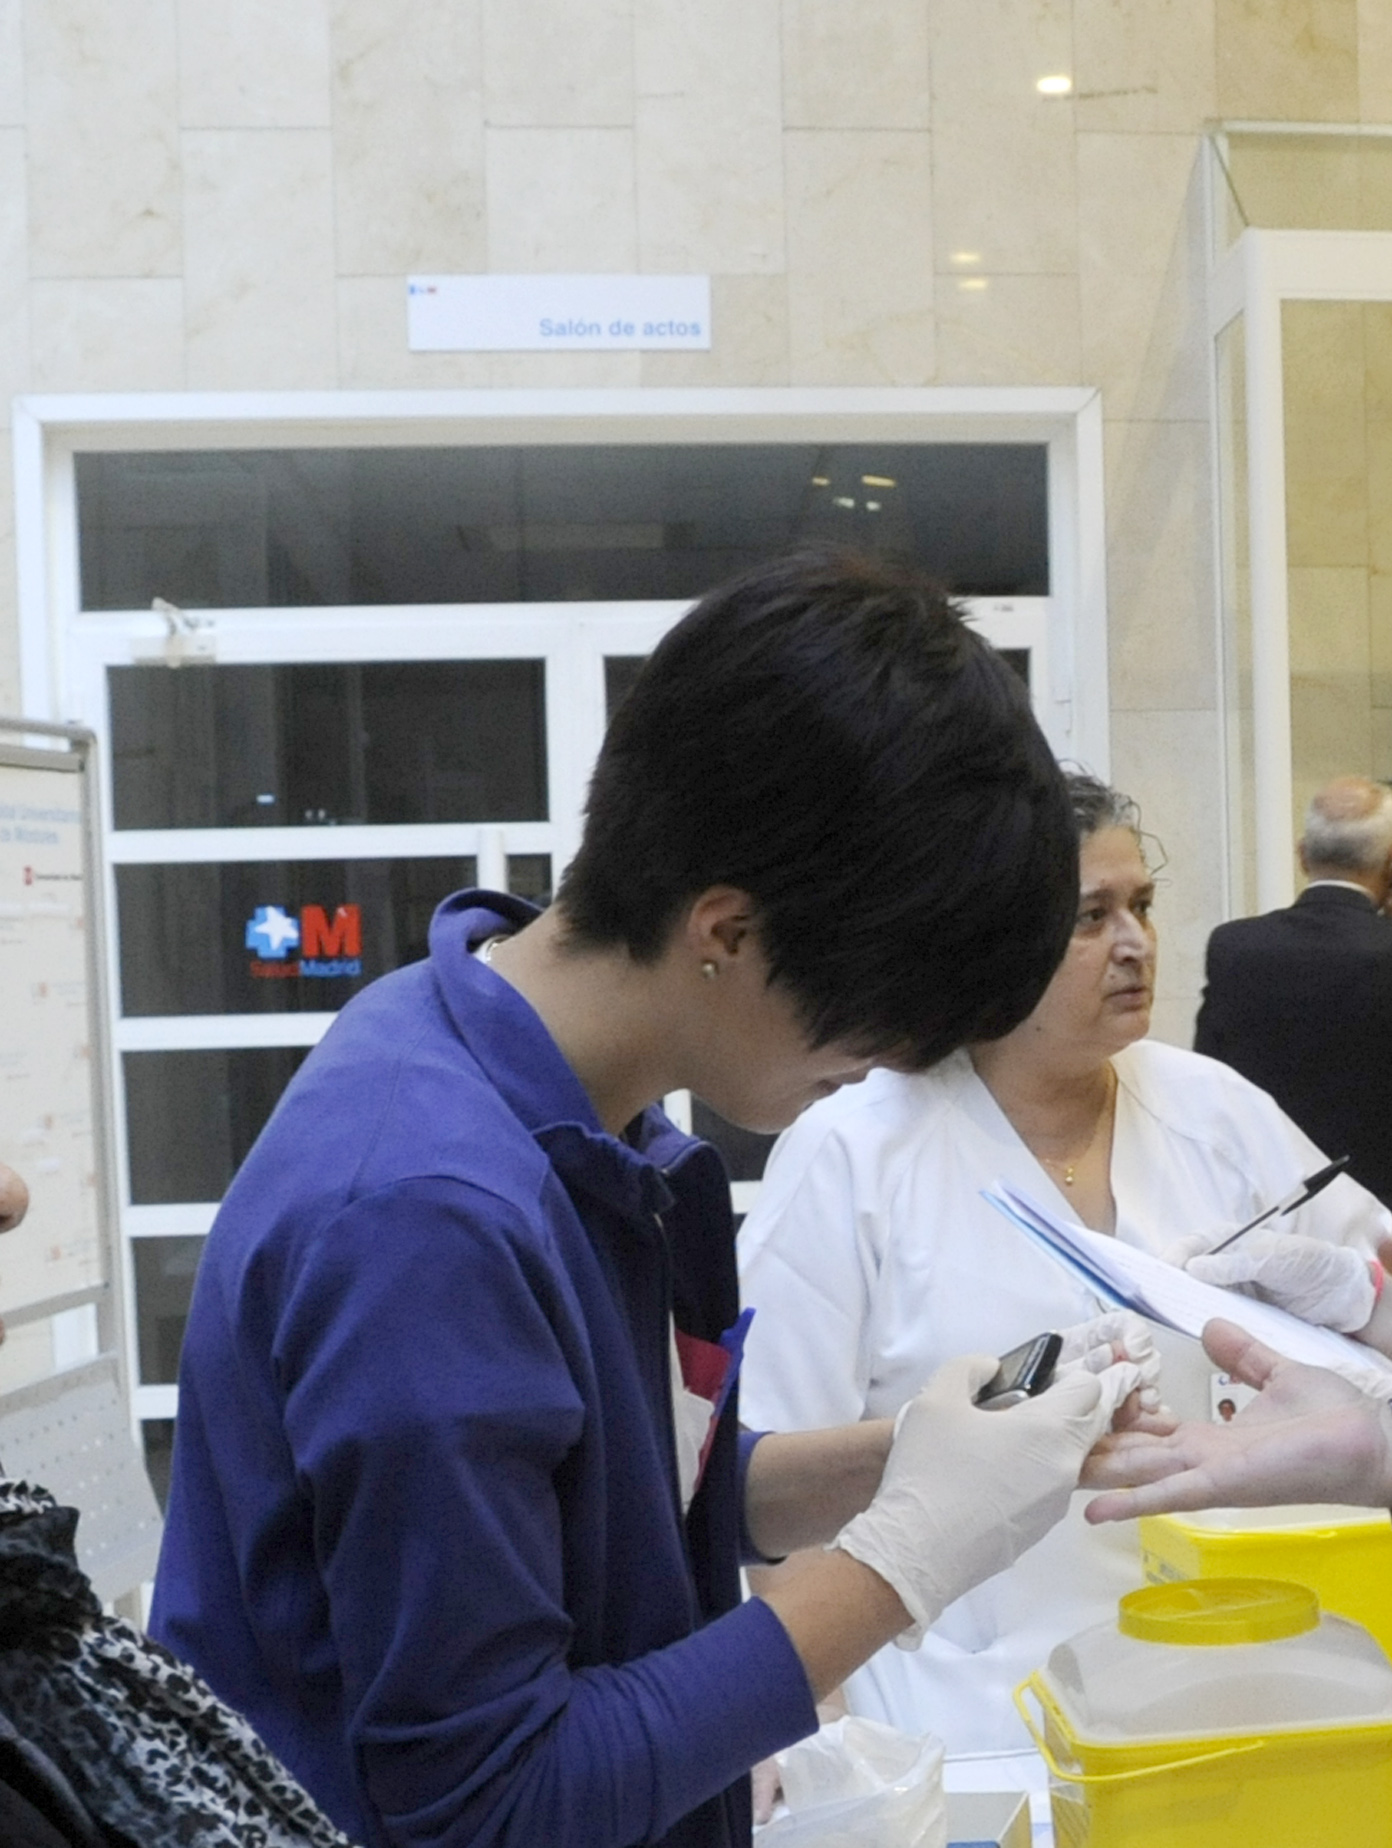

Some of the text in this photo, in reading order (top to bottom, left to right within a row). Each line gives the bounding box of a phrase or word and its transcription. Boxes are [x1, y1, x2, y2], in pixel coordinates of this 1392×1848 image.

[539, 317, 702, 337] Salón de actos
[302, 903, 361, 957] M
